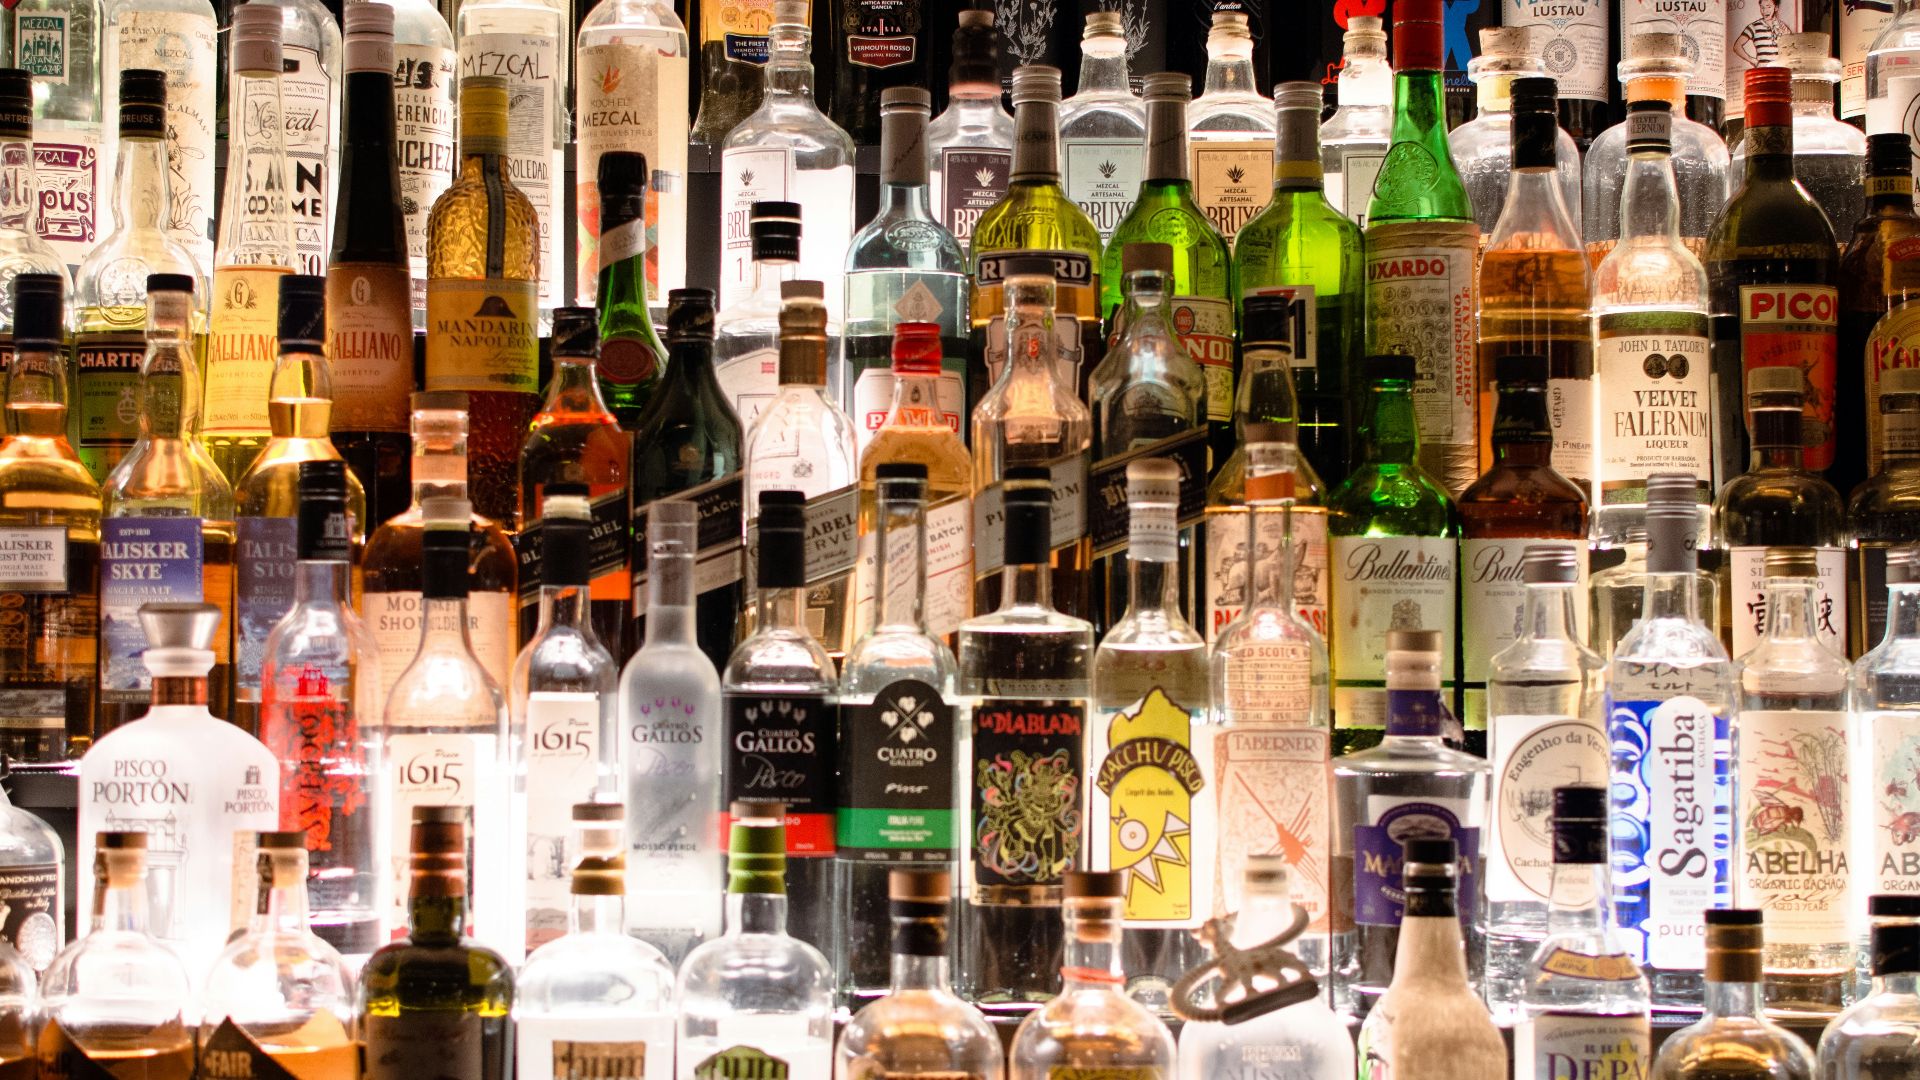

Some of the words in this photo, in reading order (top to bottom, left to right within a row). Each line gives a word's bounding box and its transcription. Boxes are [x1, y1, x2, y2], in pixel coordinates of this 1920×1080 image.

[1533, 6, 1585, 17] LUSTAU
[1655, 1, 1706, 13] LUSTAU
[22, 19, 62, 30] MEZCAL
[31, 56, 51, 64] SAN
[154, 48, 195, 60] MEZCAL
[20, 63, 63, 76] BALTAZAR
[462, 51, 550, 80] MEZCAL
[397, 94, 433, 104] EZCAL
[121, 113, 154, 124] TREUSE
[397, 104, 447, 126] ERENCIA
[582, 111, 641, 127] MEZCAL
[404, 124, 417, 136] DE
[507, 159, 548, 180] SOLEDAD
[1873, 178, 1895, 191] 1936
[727, 209, 751, 240] BRU
[1079, 202, 1135, 230] BRUX
[1206, 206, 1265, 234] BRUX
[982, 261, 1088, 280] RIRD
[209, 331, 278, 369] GALLIANO
[326, 328, 401, 366] GALLIANO
[1454, 294, 1463, 396] MARASCHINO
[1462, 286, 1472, 406] ORIGINALE
[1618, 340, 1649, 353] JOHN
[1652, 340, 1661, 352] D.
[1633, 390, 1698, 408] VELVET
[1614, 411, 1708, 438] FALERNUM
[1646, 440, 1689, 449] LIQUEUR
[929, 525, 964, 544] BATCH
[102, 541, 190, 560] TALISKER
[927, 543, 951, 557] INISH
[111, 563, 163, 580] SKYE
[253, 562, 294, 578] STO
[140, 585, 172, 595] MALT
[757, 727, 800, 738] CUATRO
[993, 710, 1082, 736] DIABLADA
[632, 724, 704, 744] GALLOS
[735, 731, 816, 754] GALLOS
[1231, 733, 1324, 754] TABERNERO
[1565, 731, 1583, 745] da
[533, 720, 593, 770] 1615
[876, 746, 938, 763] CUATRO
[1098, 740, 1168, 794] MACCHU
[1170, 748, 1203, 794] PISCO
[1507, 734, 1562, 783] Engenho
[113, 759, 167, 778] PISCO
[398, 752, 464, 800] 1615
[92, 778, 190, 807] PORTÓN
[236, 789, 268, 801] PISCO
[1658, 712, 1708, 879] Sagatiba
[224, 800, 276, 814] PORTÓN
[1745, 849, 1849, 876] ABELHA
[1879, 851, 1920, 876] AB
[1748, 877, 1802, 890] ORGANIC
[1882, 880, 1920, 892] ORGAN
[1771, 902, 1793, 912] AGED
[1802, 902, 1829, 912] YEARS
[210, 1050, 252, 1075] FAIR
